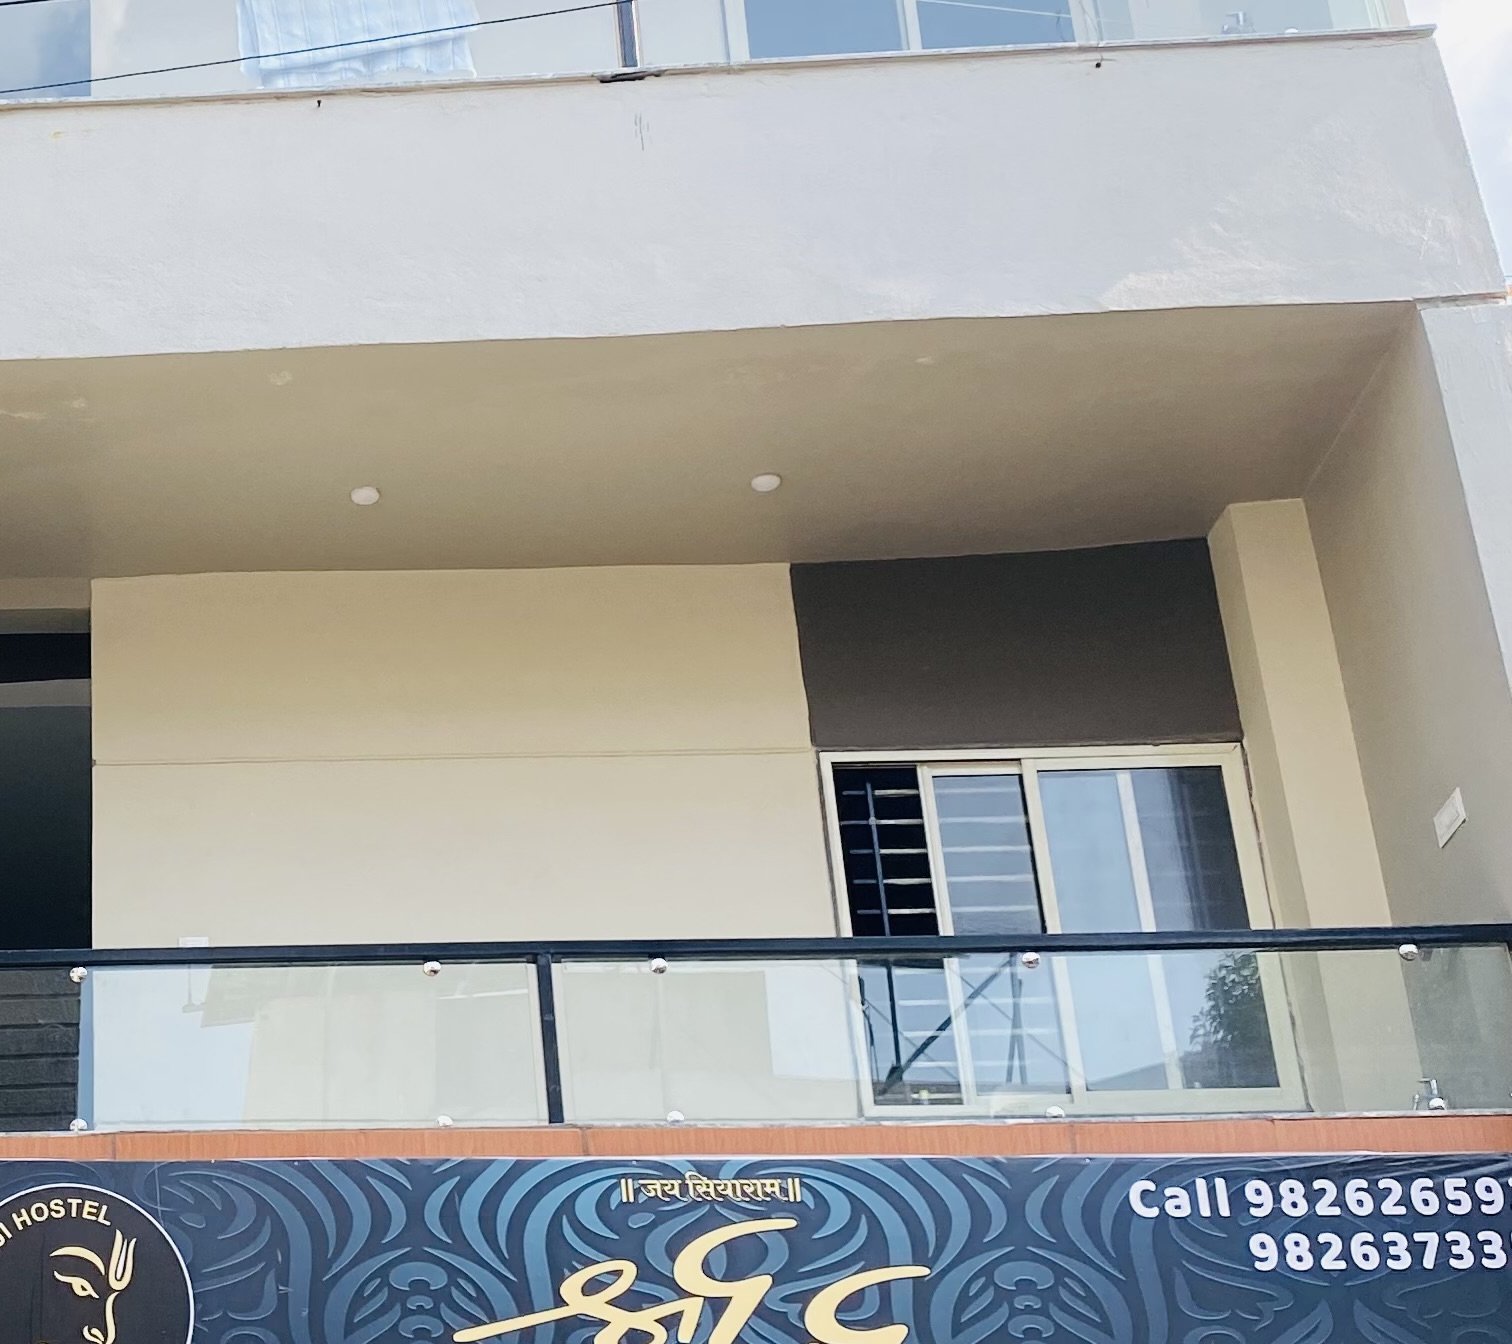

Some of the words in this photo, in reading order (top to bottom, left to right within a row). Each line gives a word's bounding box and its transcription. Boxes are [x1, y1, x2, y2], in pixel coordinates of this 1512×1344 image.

[11, 1197, 112, 1231] HOSTEL
[1129, 1178, 1231, 1218] Call
[1243, 1176, 1512, 1218] 98262659
[1248, 1230, 1512, 1272] 98263733
